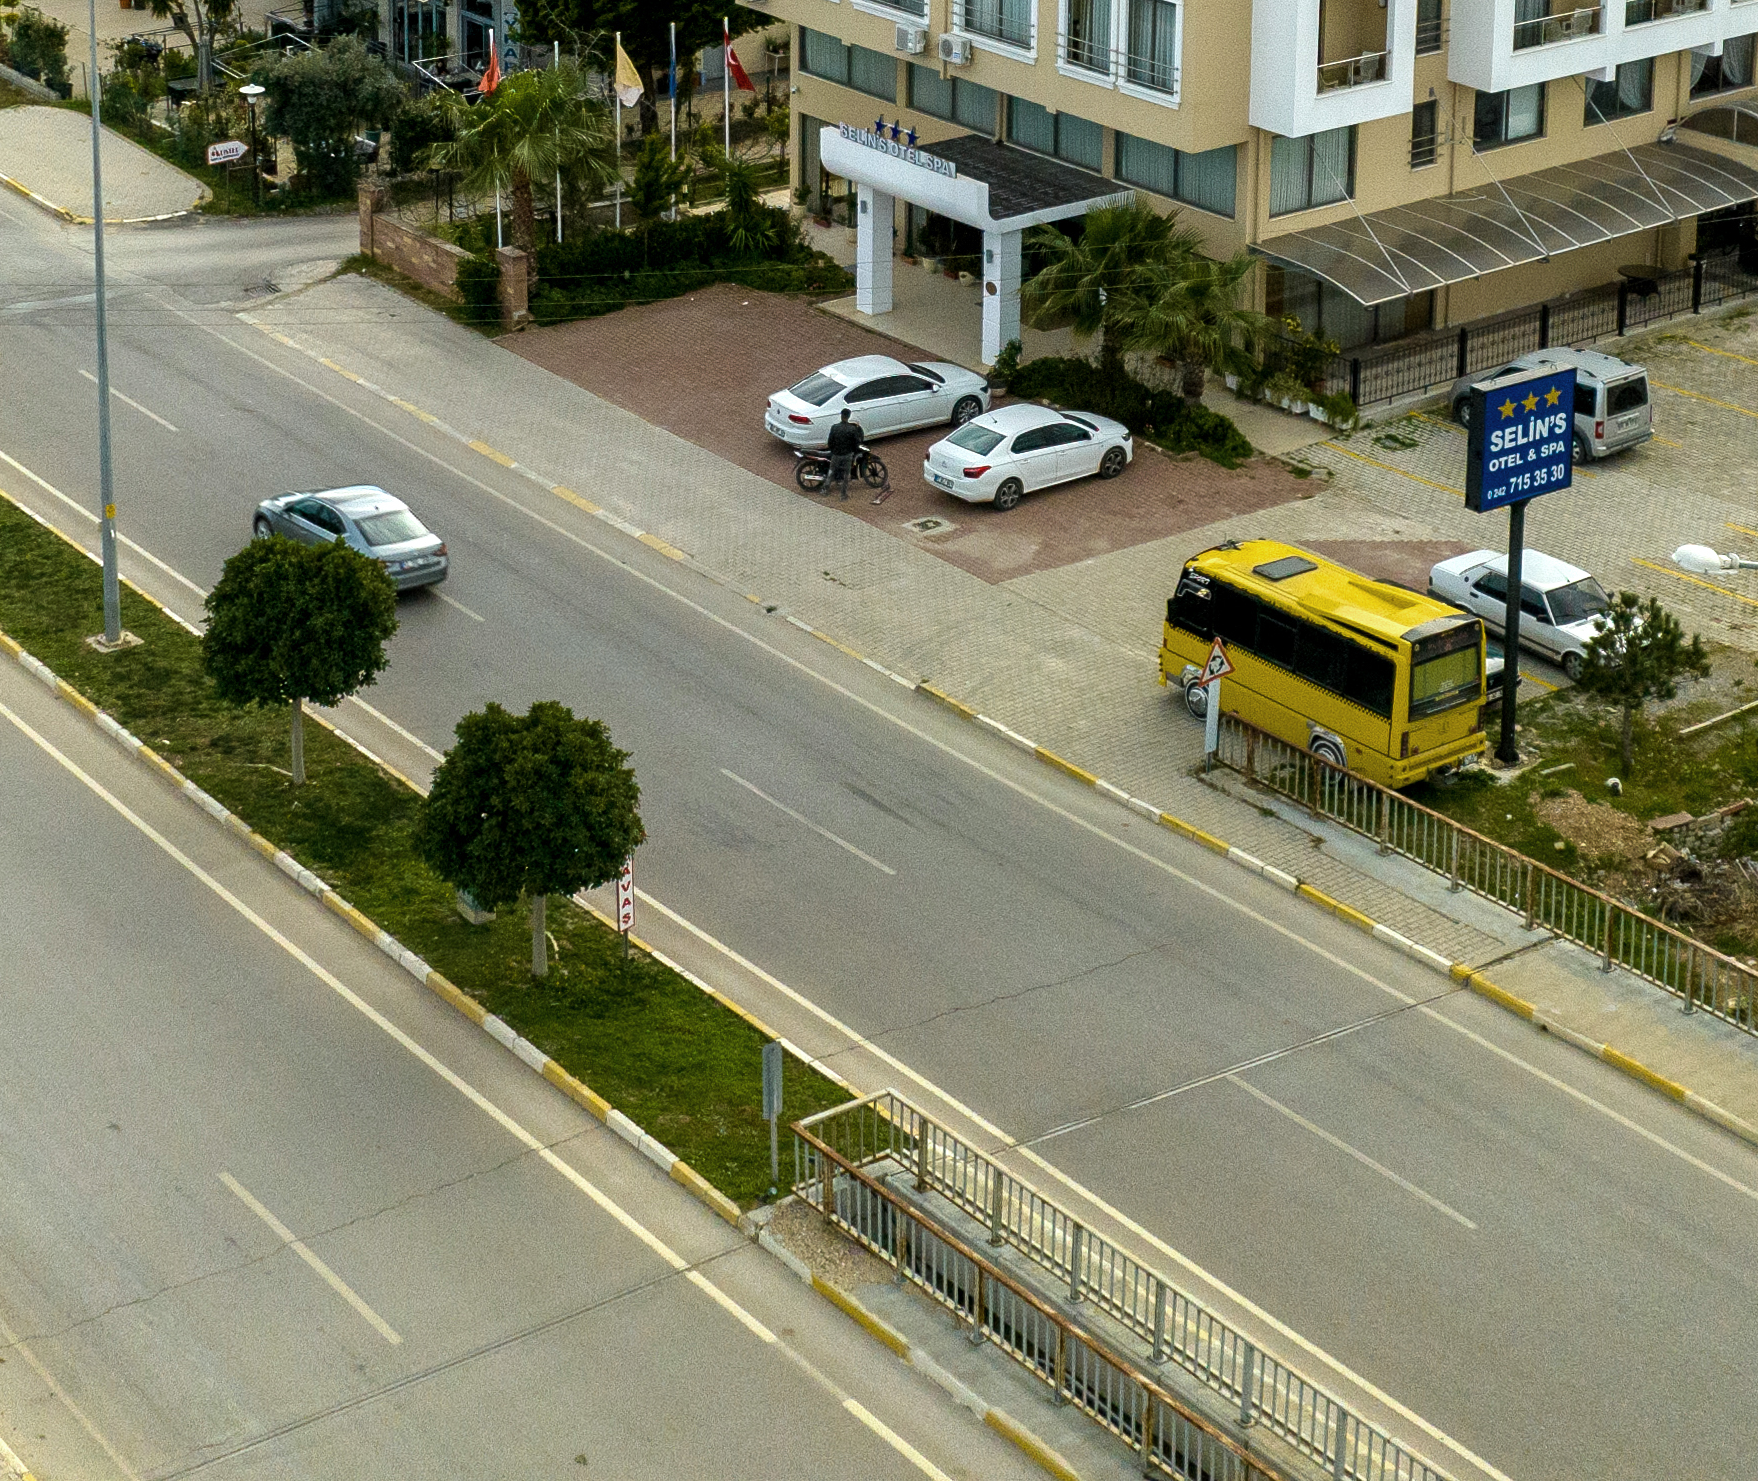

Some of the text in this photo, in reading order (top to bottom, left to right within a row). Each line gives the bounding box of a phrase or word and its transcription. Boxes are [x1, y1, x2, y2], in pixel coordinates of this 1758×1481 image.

[889, 141, 923, 165] OTEL
[1490, 413, 1567, 452] SELİN'S
[1489, 441, 1565, 472] OTEL & SPA
[1487, 463, 1565, 499] 0 242 715 35 30
